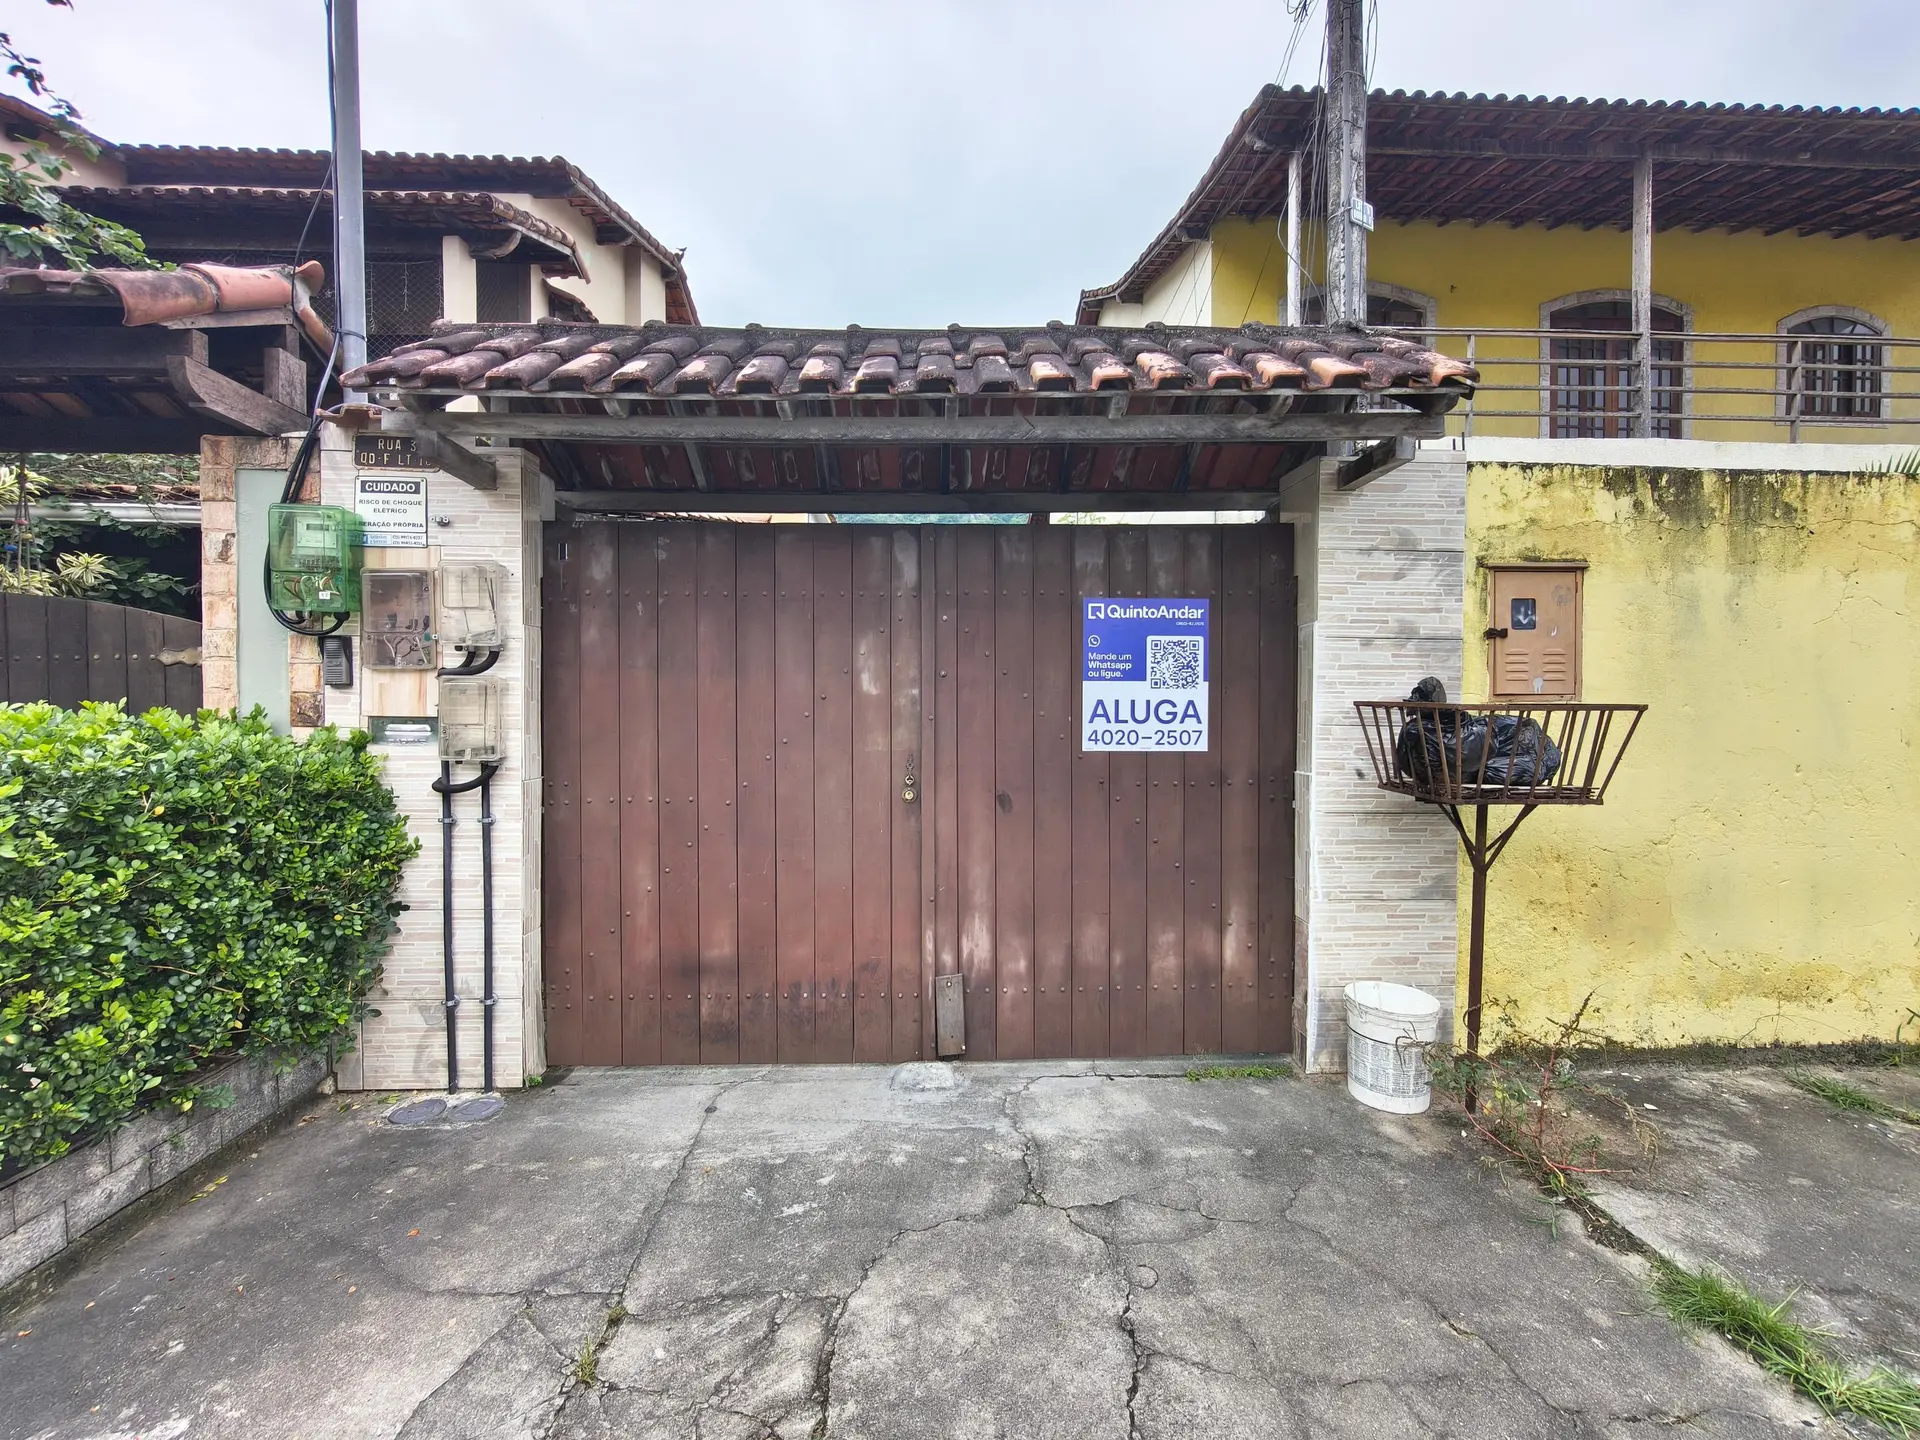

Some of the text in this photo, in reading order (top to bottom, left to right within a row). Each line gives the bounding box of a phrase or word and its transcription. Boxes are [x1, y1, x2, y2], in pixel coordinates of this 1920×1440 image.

[378, 438, 417, 451] RUA 3
[365, 482, 416, 492] CUIDADO
[1107, 605, 1204, 619] QuintoAndar
[1088, 661, 1132, 670] Whatsapp
[1101, 670, 1124, 679] ligue.
[1088, 699, 1202, 724] ALUGA
[1088, 729, 1203, 746] 4020-2507
